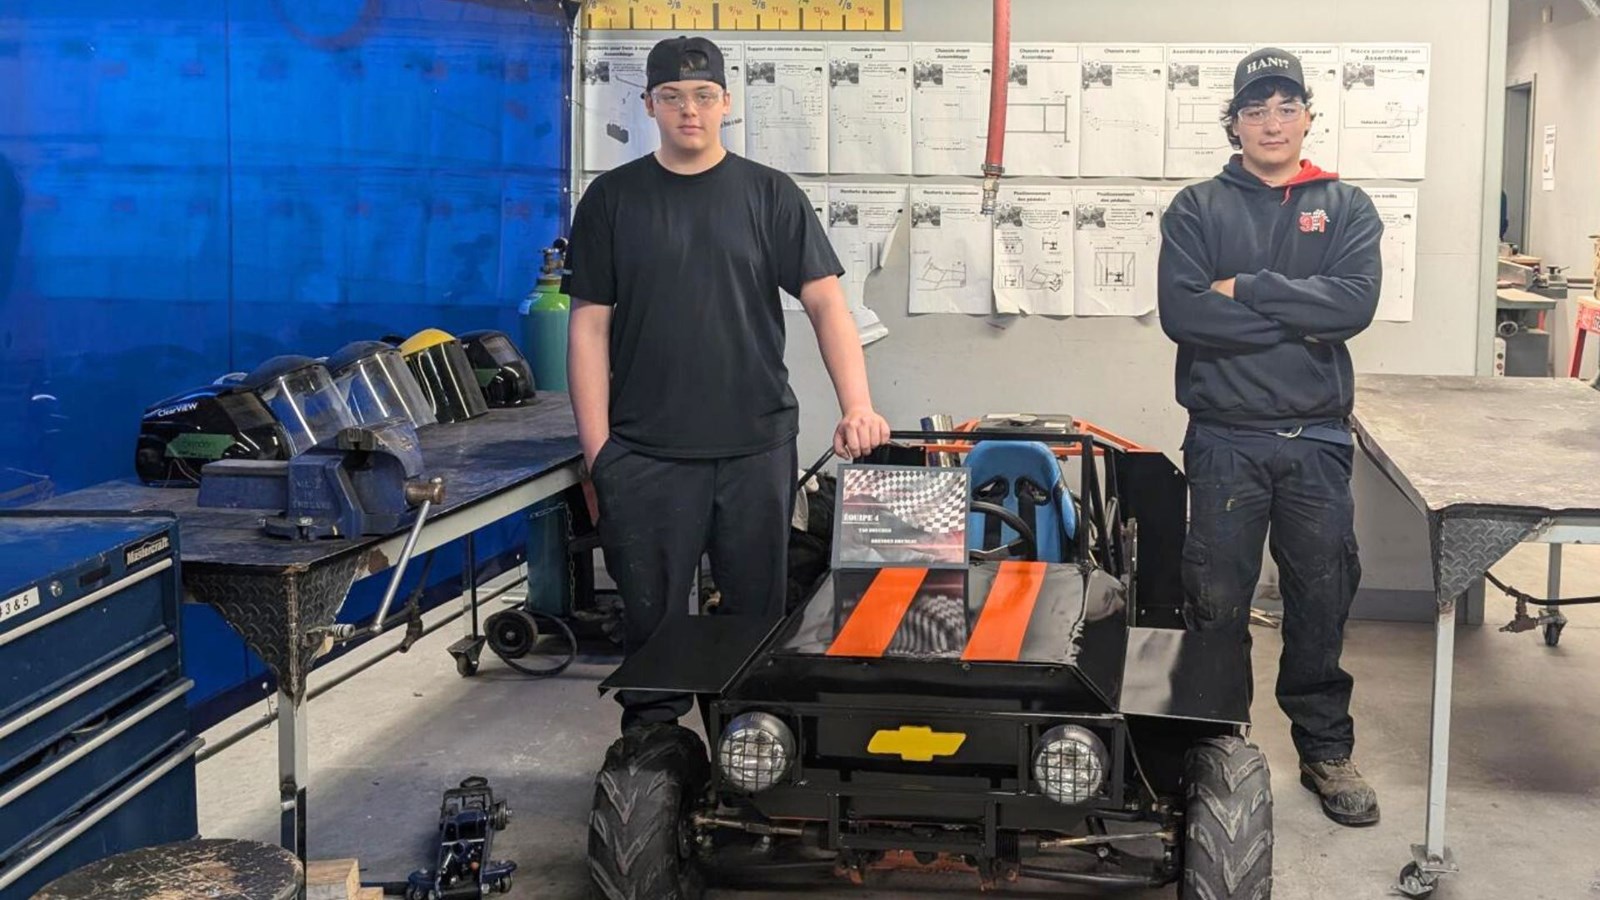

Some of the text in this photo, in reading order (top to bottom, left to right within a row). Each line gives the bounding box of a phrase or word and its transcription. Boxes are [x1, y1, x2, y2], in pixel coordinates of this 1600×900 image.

[127, 537, 169, 566] Mastercraft
[5, 594, 29, 615] 3 & 5
